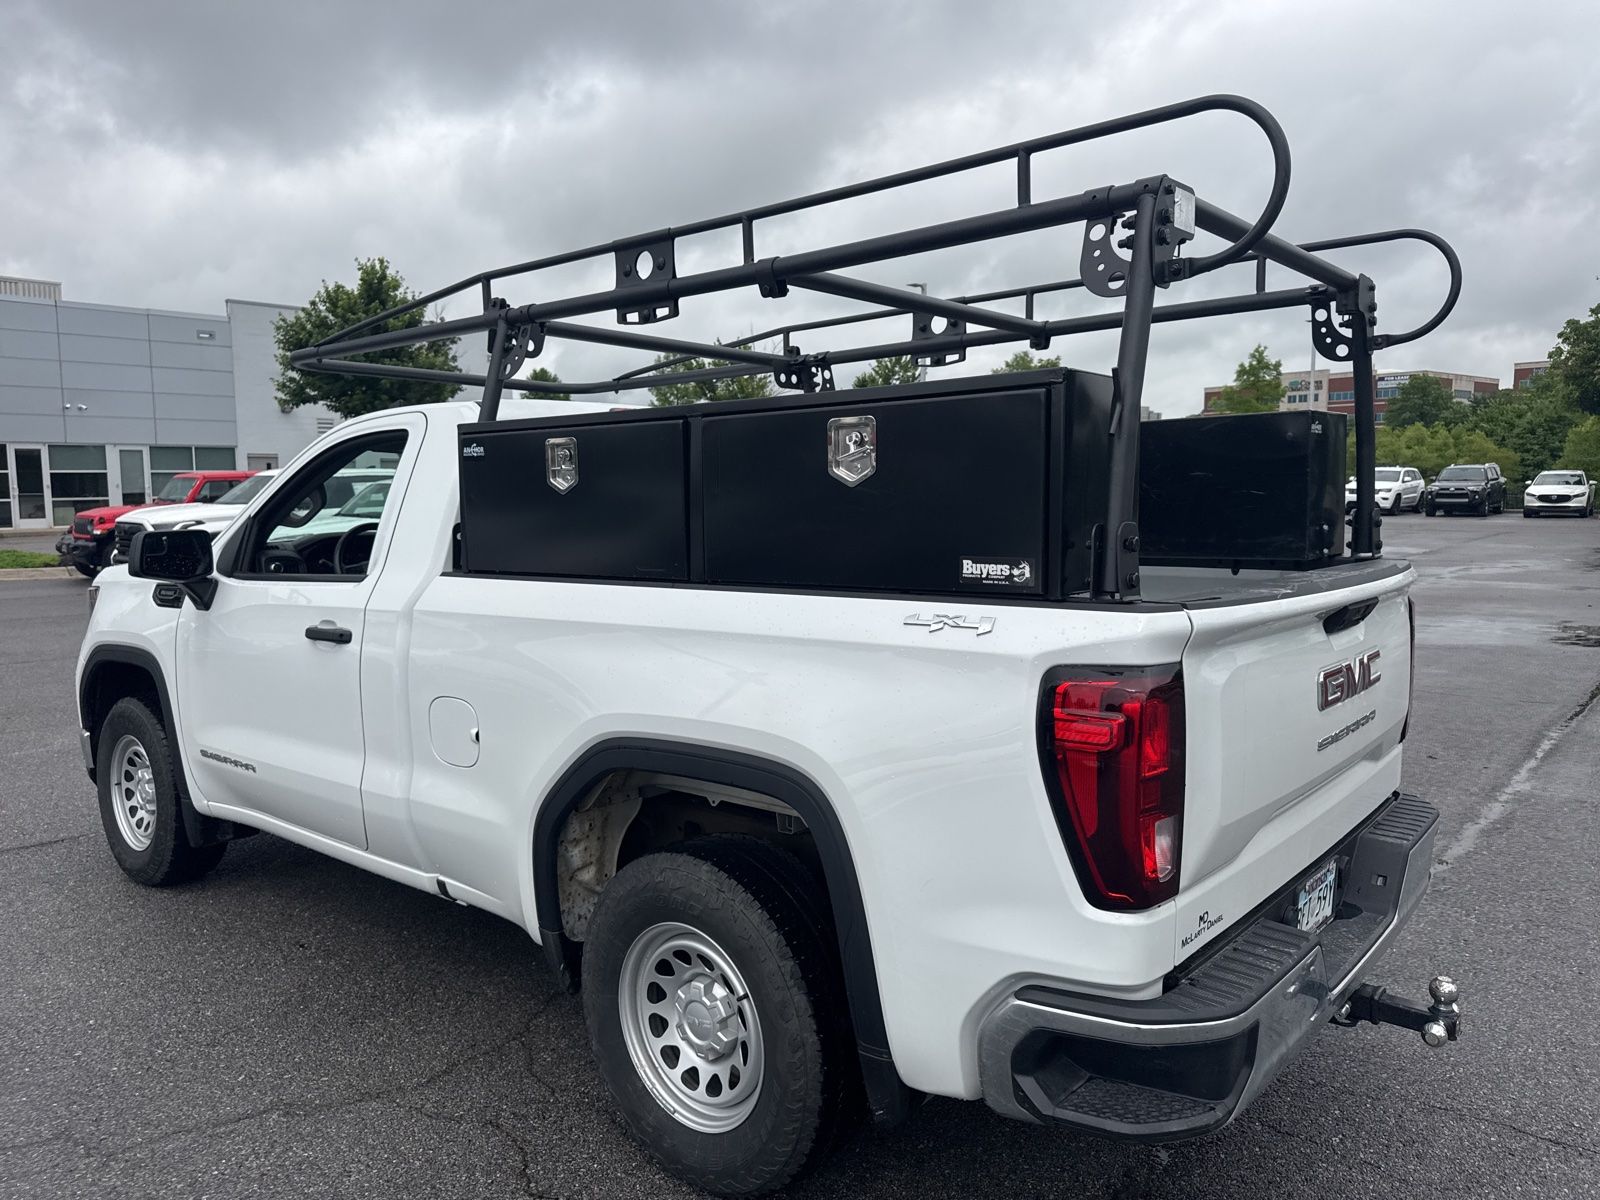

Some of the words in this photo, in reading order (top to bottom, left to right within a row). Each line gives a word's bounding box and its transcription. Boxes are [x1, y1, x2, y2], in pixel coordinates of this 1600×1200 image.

[962, 559, 1010, 578] Buyers
[1317, 649, 1382, 712] GMC
[1317, 709, 1376, 752] SIERRA
[199, 749, 257, 774] SIERRA
